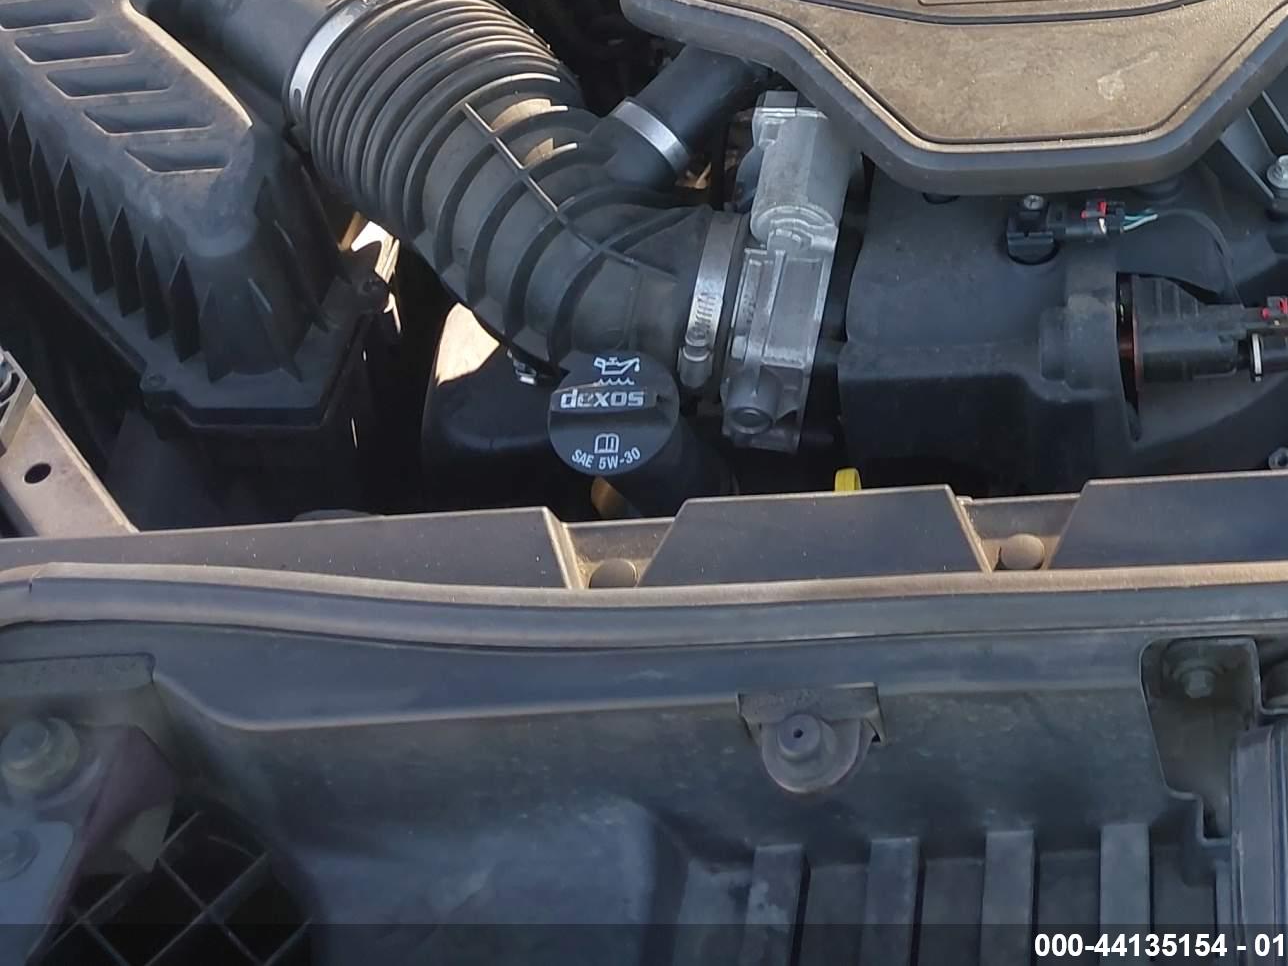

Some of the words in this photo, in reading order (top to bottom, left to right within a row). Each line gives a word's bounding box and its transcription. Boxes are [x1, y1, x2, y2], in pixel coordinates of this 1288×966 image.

[560, 388, 644, 409] dexos
[572, 449, 594, 468] SAE
[599, 448, 641, 469] 5W-30
